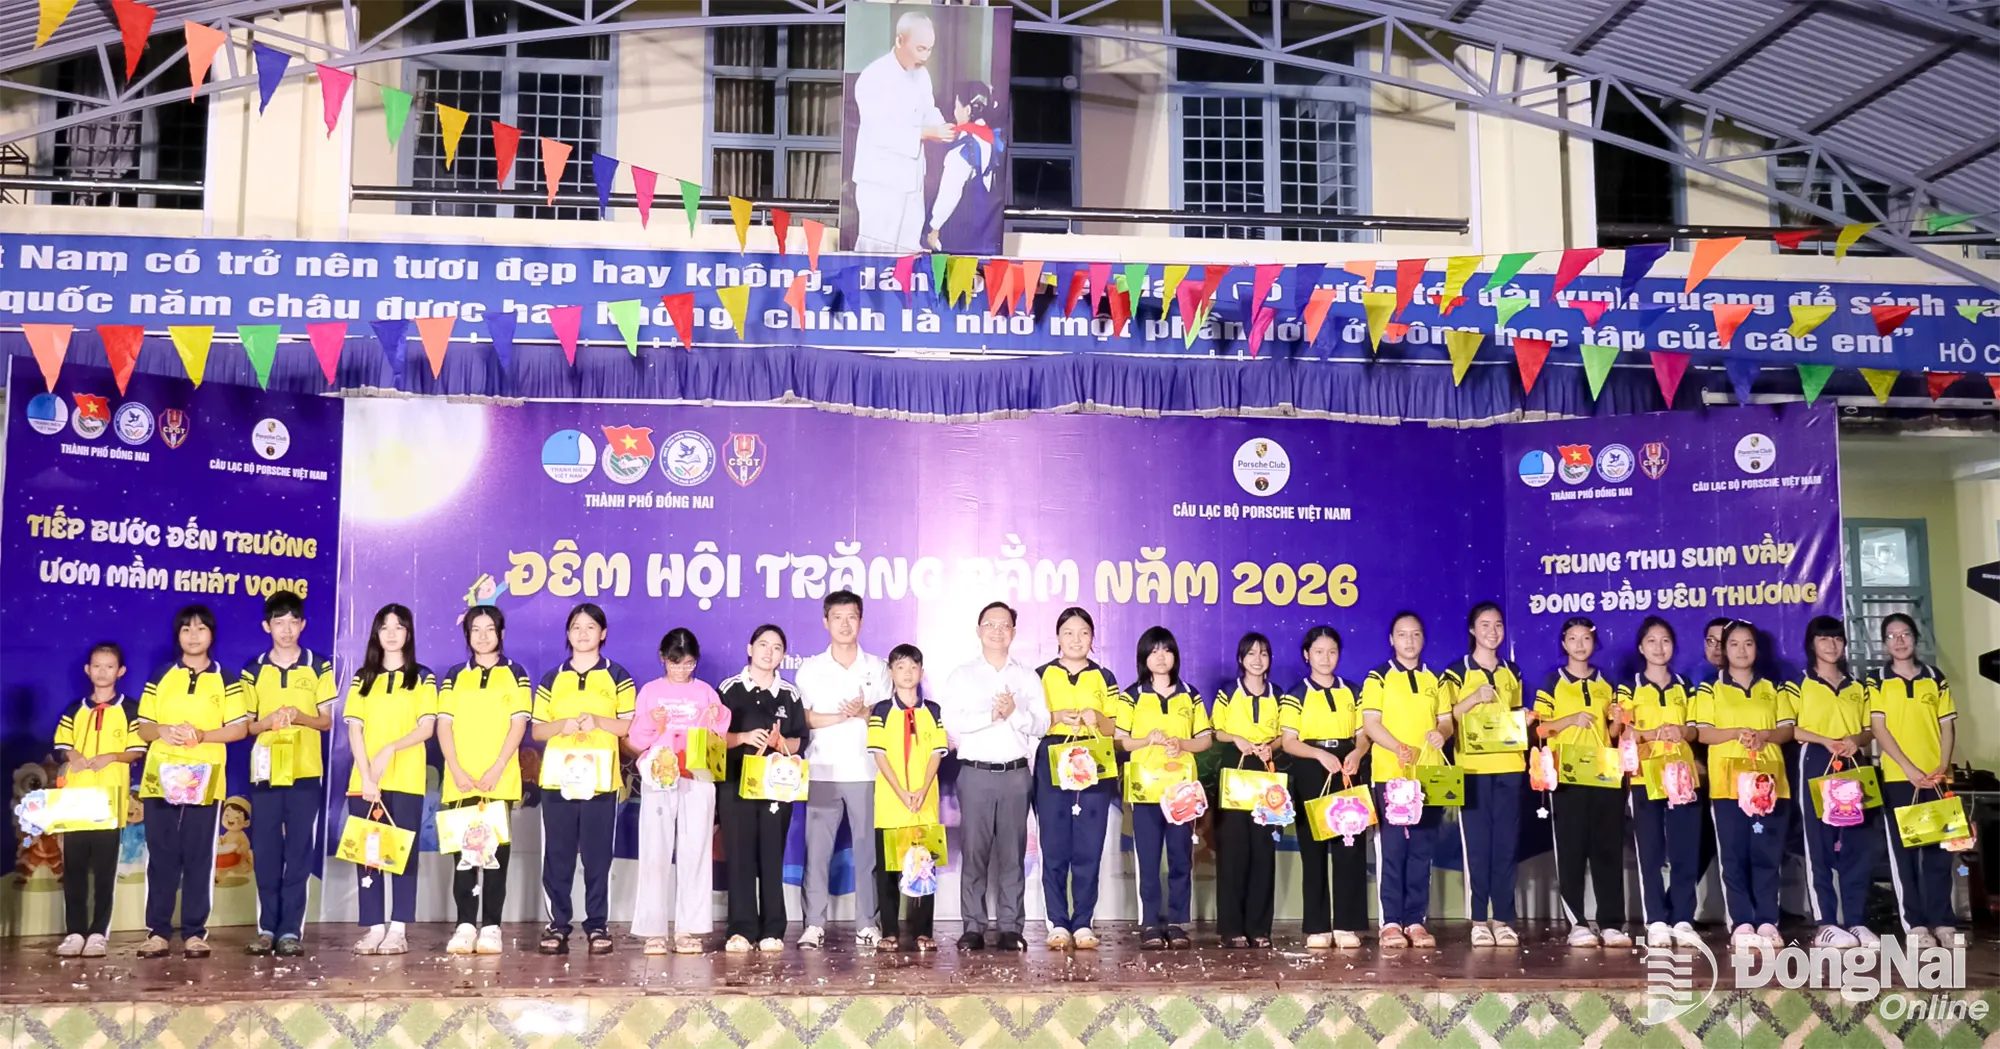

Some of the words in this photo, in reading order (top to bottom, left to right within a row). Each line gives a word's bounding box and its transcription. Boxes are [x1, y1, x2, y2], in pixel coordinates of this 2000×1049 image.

[145, 249, 201, 274] có
[217, 249, 282, 276] trở
[296, 252, 378, 278] nên
[394, 255, 479, 280] tươi
[496, 257, 577, 286] đẹp
[593, 260, 671, 288] hay
[0, 285, 114, 314] quốc
[130, 288, 232, 316] năm
[248, 293, 361, 319] châu
[901, 308, 941, 333] là
[956, 308, 1035, 336] nhờ
[1342, 317, 1367, 344] ở
[1940, 338, 1977, 364] HỒ
[60, 443, 89, 456] THÀNH
[91, 445, 109, 458] PHỐ
[134, 452, 149, 462] NAI
[209, 458, 227, 470] CÂU
[227, 461, 242, 473] LẠC
[244, 462, 255, 475] BỘ
[256, 464, 291, 477] PORSCHE
[292, 467, 309, 481] VIỆT
[309, 470, 328, 481] NAM
[1237, 459, 1268, 469] Porsche
[1269, 460, 1286, 469] Club
[585, 492, 625, 508] THÀNH
[627, 490, 653, 508] PHỐ
[692, 495, 714, 509] NAI
[1692, 481, 1710, 492] CÂU
[1710, 481, 1726, 492] LẠC
[1728, 479, 1740, 491] BỘ
[1741, 477, 1780, 489] PORSCHE
[1172, 502, 1196, 517] CÂU
[1199, 504, 1221, 520] LẠC
[1224, 503, 1239, 520] BỘ
[1242, 506, 1295, 519] PORSCHE
[1297, 505, 1321, 522] VIỆT
[1324, 507, 1351, 520] NAM
[27, 504, 85, 540] TIẾP
[91, 516, 160, 545] BƯỚC
[166, 516, 217, 551] ĐẾN
[222, 529, 318, 560] TRƯỜNG
[1541, 550, 1621, 575] TRUNG
[1625, 548, 1675, 571] THU
[1681, 546, 1736, 569] SUM
[1742, 533, 1796, 566] VẦY
[40, 557, 100, 587] ƯƠM
[106, 554, 168, 591] MẦM
[174, 566, 240, 595] KHÁT
[245, 575, 309, 600] VỌNG
[509, 539, 631, 597] ĐÊM
[646, 541, 741, 611] HỘI
[755, 541, 943, 600] TRĂNG
[1094, 546, 1219, 604] NĂM
[1232, 561, 1359, 607] 2026
[1529, 592, 1595, 614] ĐONG
[1600, 579, 1652, 612] ĐẦY
[1657, 582, 1707, 611] YÊU
[1712, 582, 1817, 607] THƯƠNG
